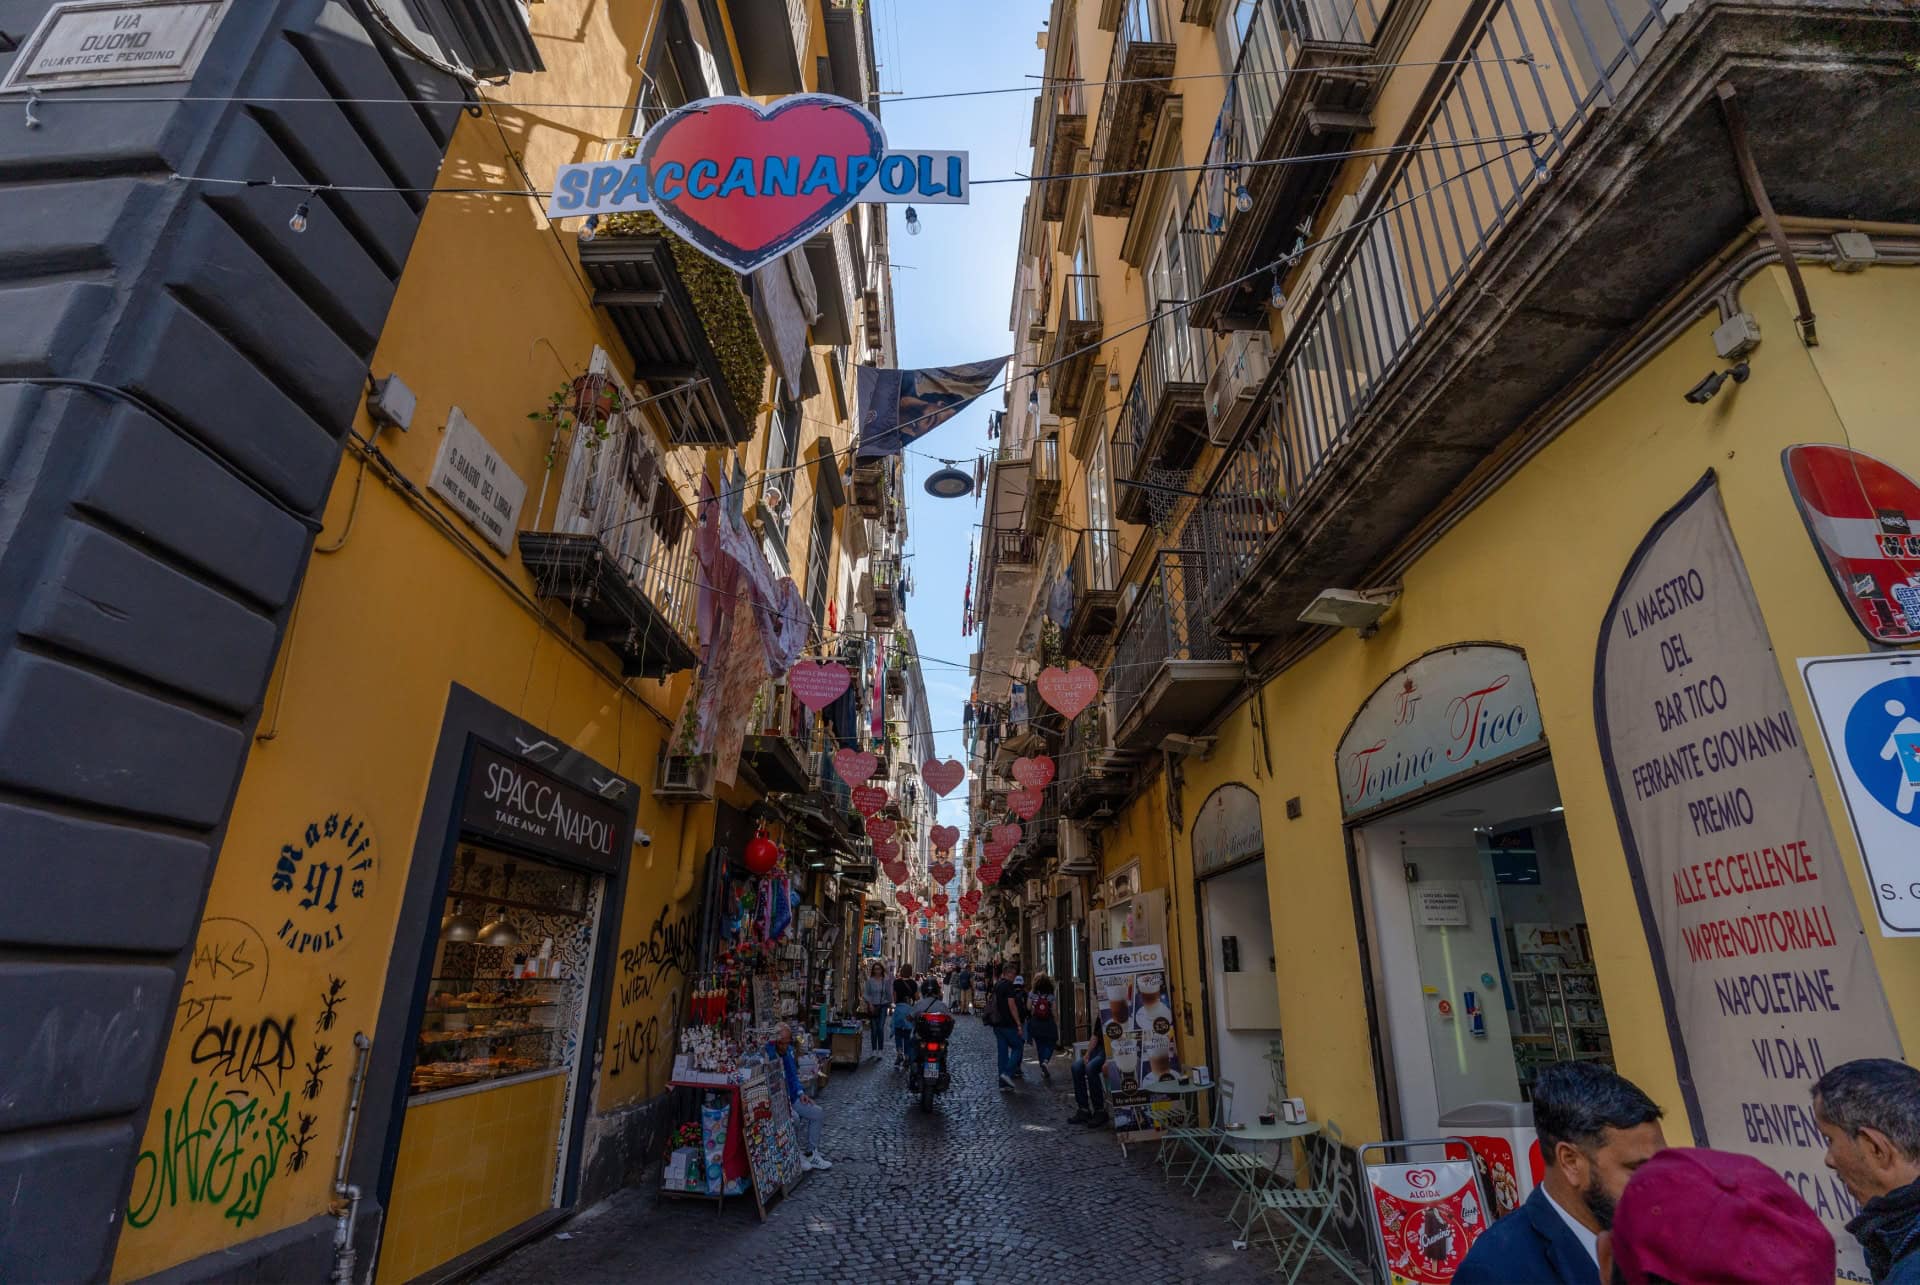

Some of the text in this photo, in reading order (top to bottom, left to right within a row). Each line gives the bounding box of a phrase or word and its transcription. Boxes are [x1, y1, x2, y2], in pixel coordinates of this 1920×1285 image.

[80, 32, 153, 51] DUOMO
[113, 14, 143, 30] VIA
[39, 51, 176, 69] QUARTIERE PENDINO
[556, 154, 963, 211] SPACCANAPOLI
[484, 453, 497, 476] VIA
[1622, 568, 1704, 639] IL MAESTRO
[1660, 633, 1693, 673] DEL
[1654, 675, 1727, 733] BAR TICO
[1345, 674, 1529, 807] Tonino Tico
[1632, 711, 1798, 801] FERRANTE GIOVANNI
[496, 810, 547, 837] TAKE AWAY
[1688, 787, 1754, 837] PREMIO
[299, 862, 344, 913] 91
[1673, 840, 1818, 907] ALLE ECCELLENZE
[277, 918, 344, 953] NAPOLI
[1682, 905, 1837, 963] IMPRENDITORIALI
[1098, 951, 1158, 967] Caffè Tico
[1714, 968, 1841, 1017] NAPOLETANE
[1752, 1038, 1778, 1080] VI
[1742, 1103, 1826, 1149] BENVEN
[1409, 1190, 1441, 1199] ALGIDA
